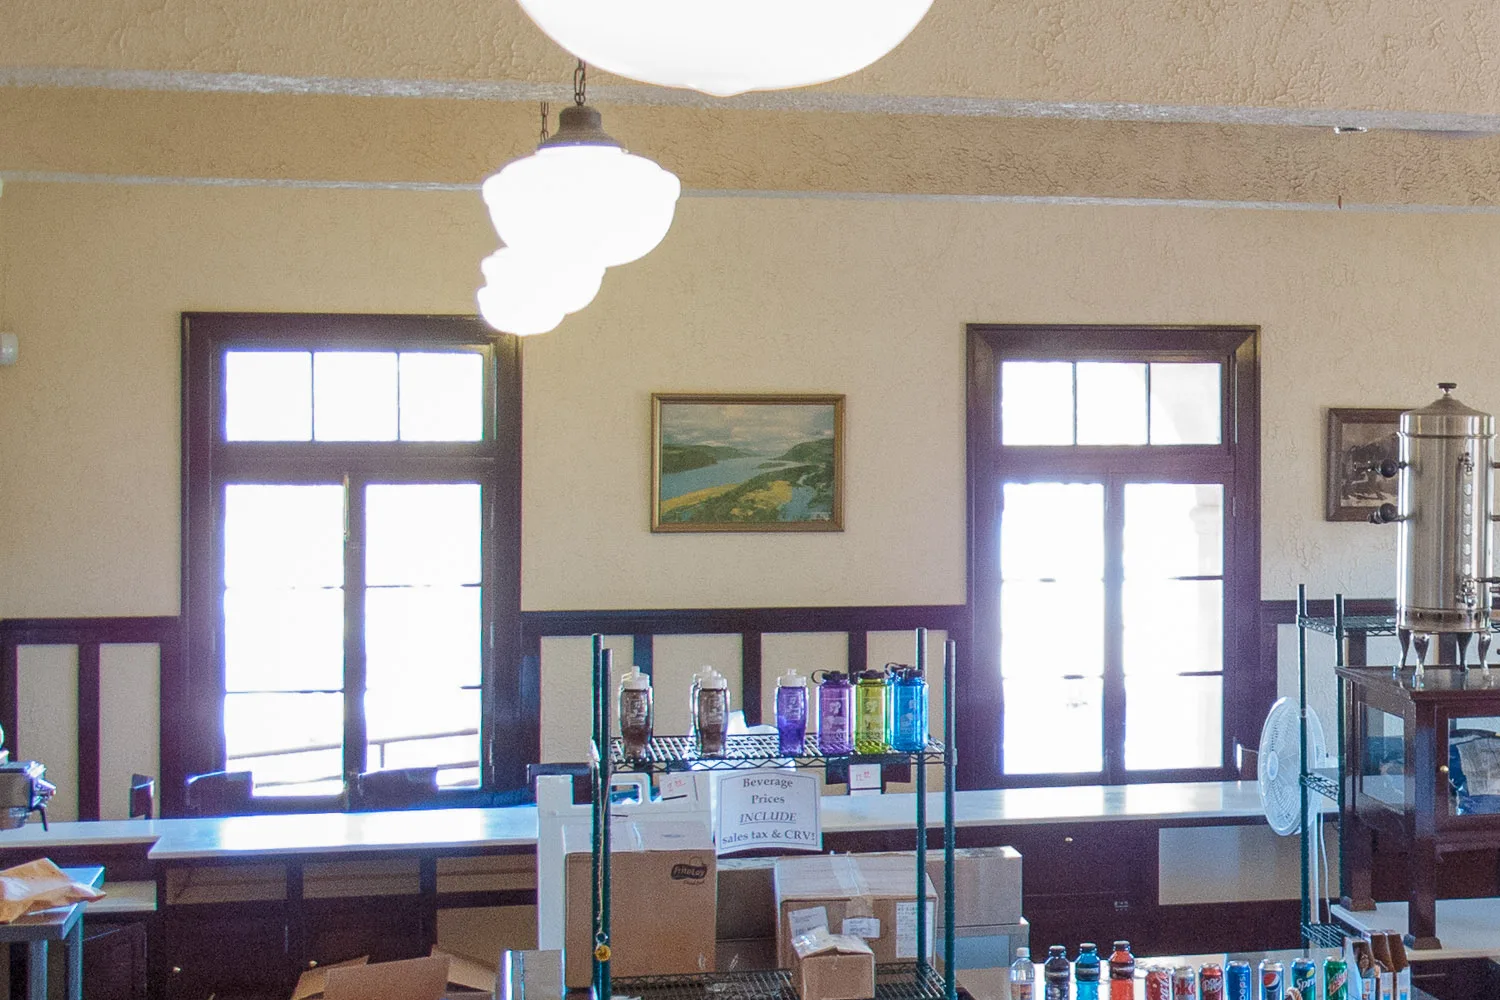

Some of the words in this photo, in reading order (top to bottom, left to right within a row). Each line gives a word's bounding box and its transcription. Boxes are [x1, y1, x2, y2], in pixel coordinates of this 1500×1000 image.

[742, 778, 794, 789] Beverage
[751, 793, 786, 804] Prices
[740, 811, 797, 824] INCLUDE
[722, 832, 749, 845] sales
[751, 831, 768, 840] tax
[771, 829, 782, 839] &
[784, 829, 816, 841] CRV!
